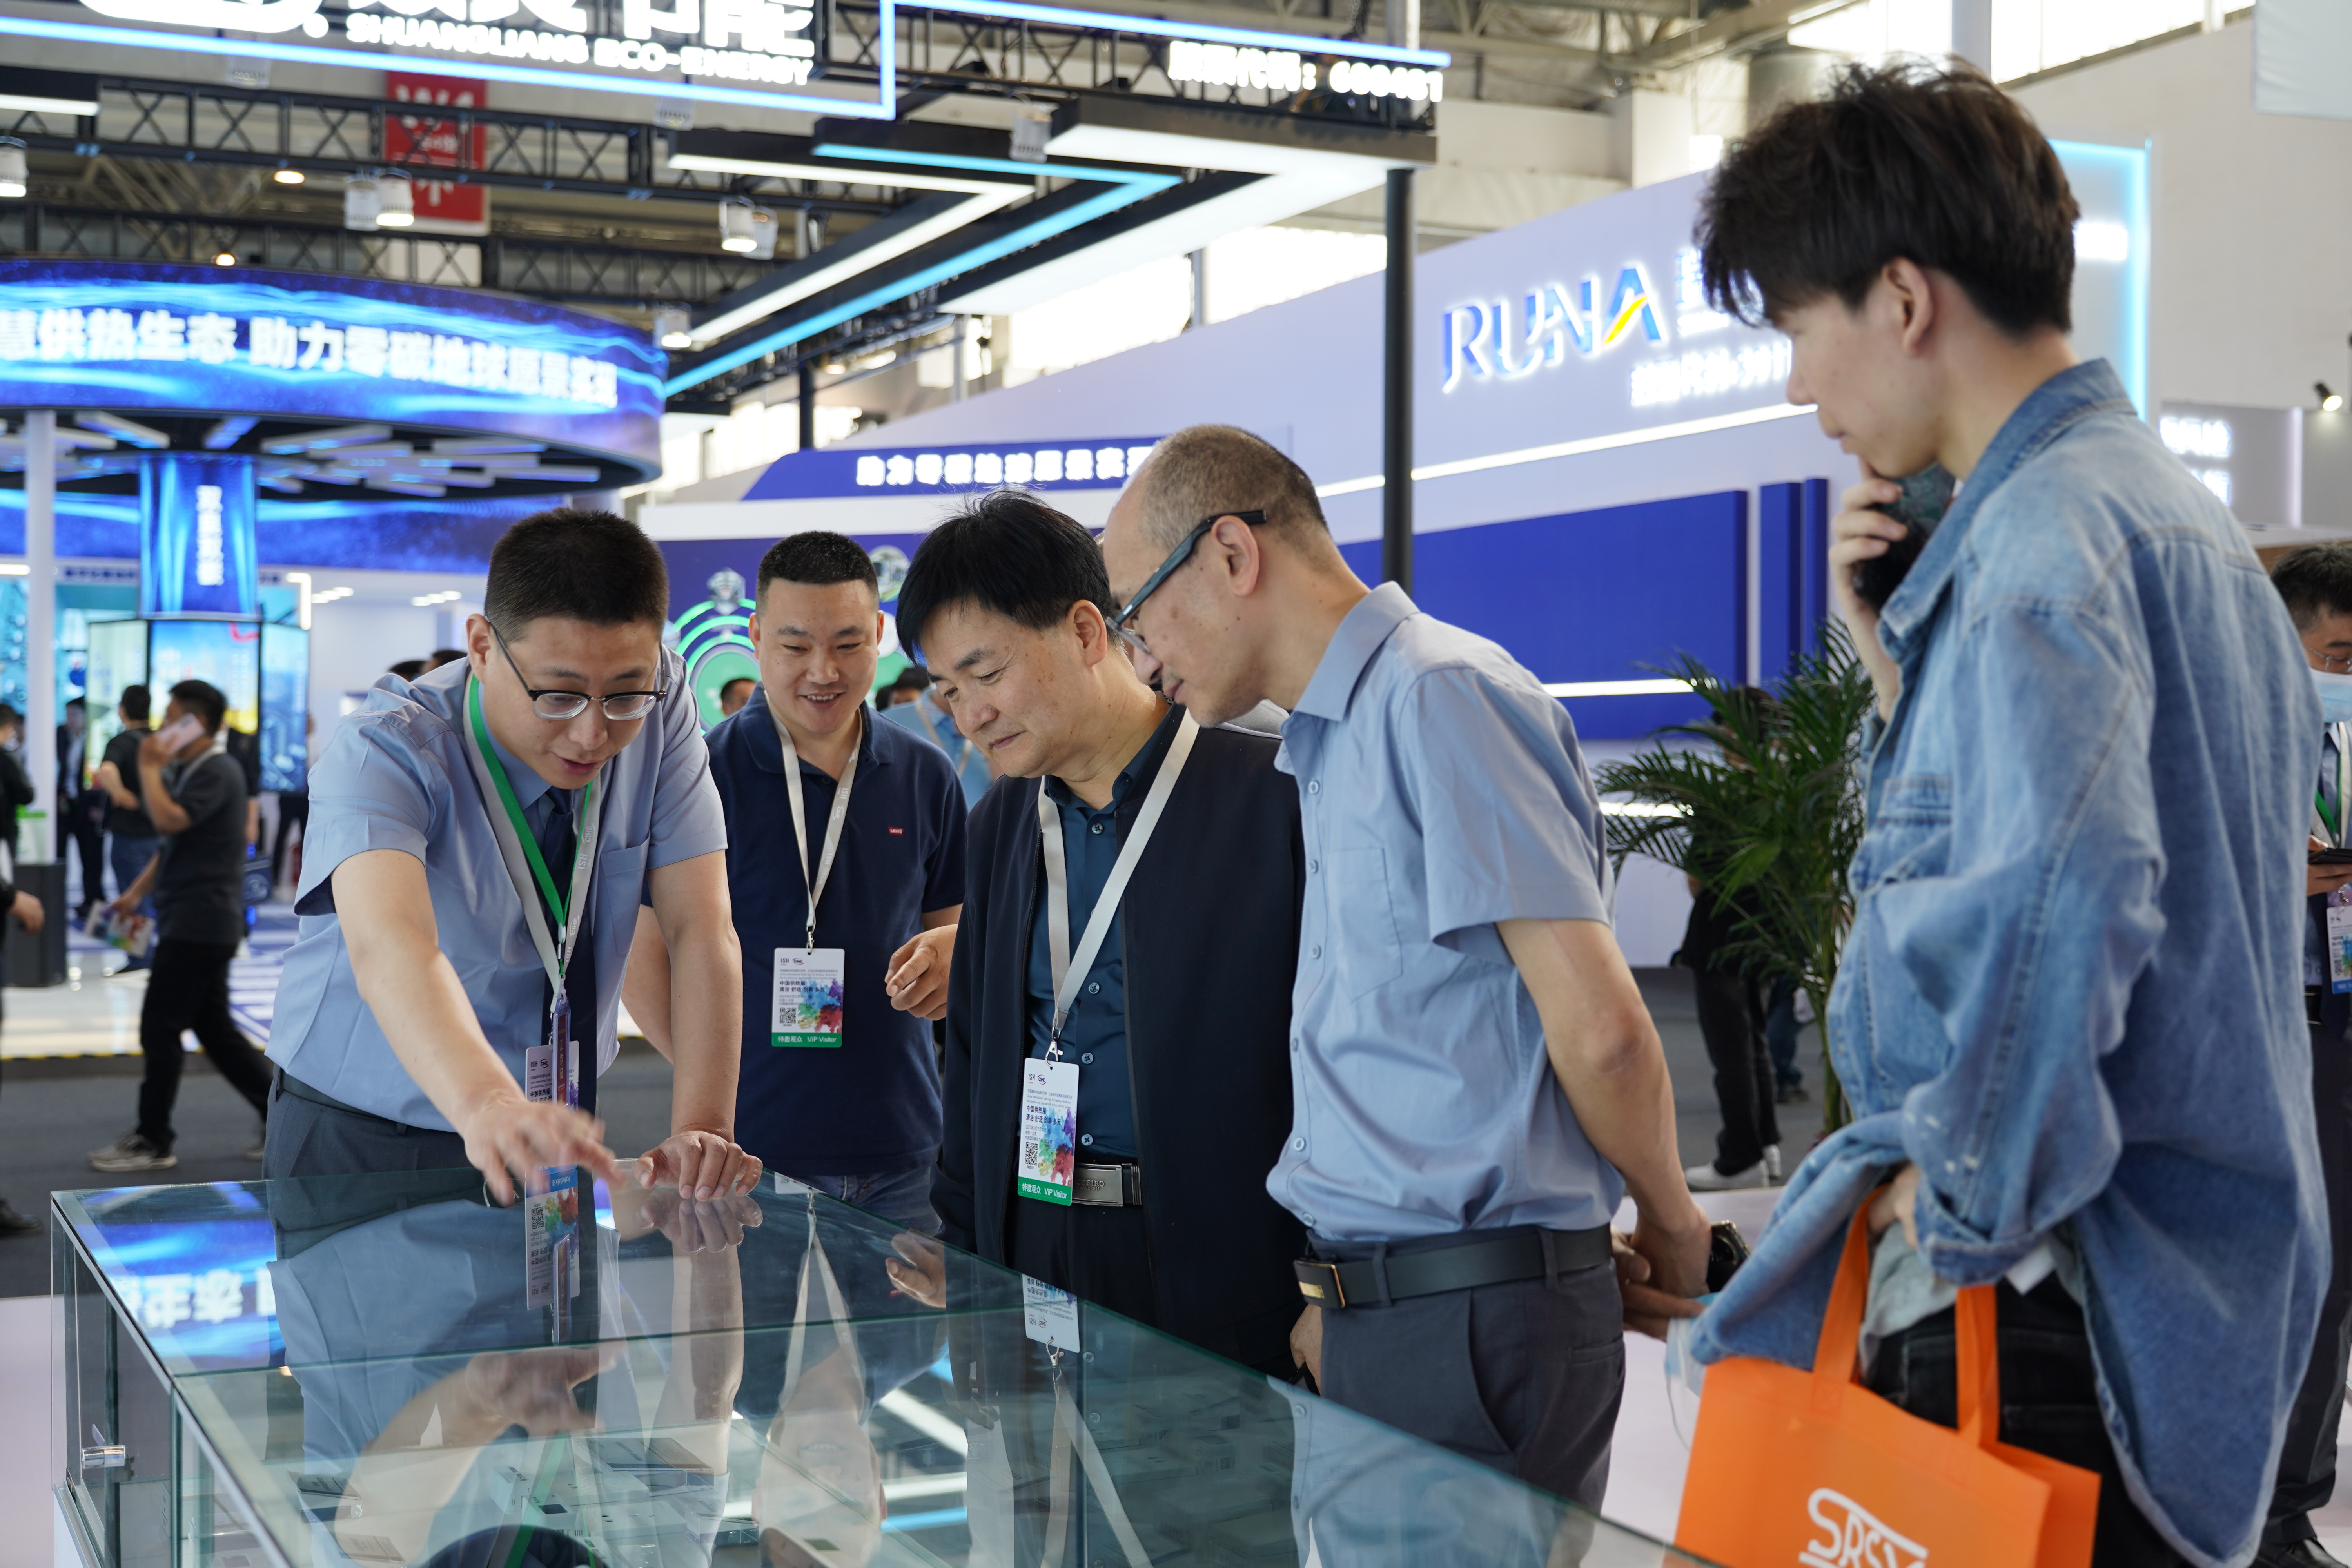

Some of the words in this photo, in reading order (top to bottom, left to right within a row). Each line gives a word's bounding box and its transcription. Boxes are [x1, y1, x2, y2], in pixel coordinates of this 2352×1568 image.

[347, 13, 589, 64] SHUANGLIANG
[593, 38, 814, 85] ECO-ENERGY
[1442, 261, 1668, 394] RUNA
[577, 854, 588, 869] ISH
[530, 1088, 550, 1098] 中国供热展
[1027, 1105, 1046, 1114] 中国供热展
[1035, 1115, 1043, 1123] 舒适
[1044, 1116, 1052, 1125] 创新
[1022, 1183, 1041, 1194] 特邀观众
[1053, 1189, 1067, 1199] Visitor
